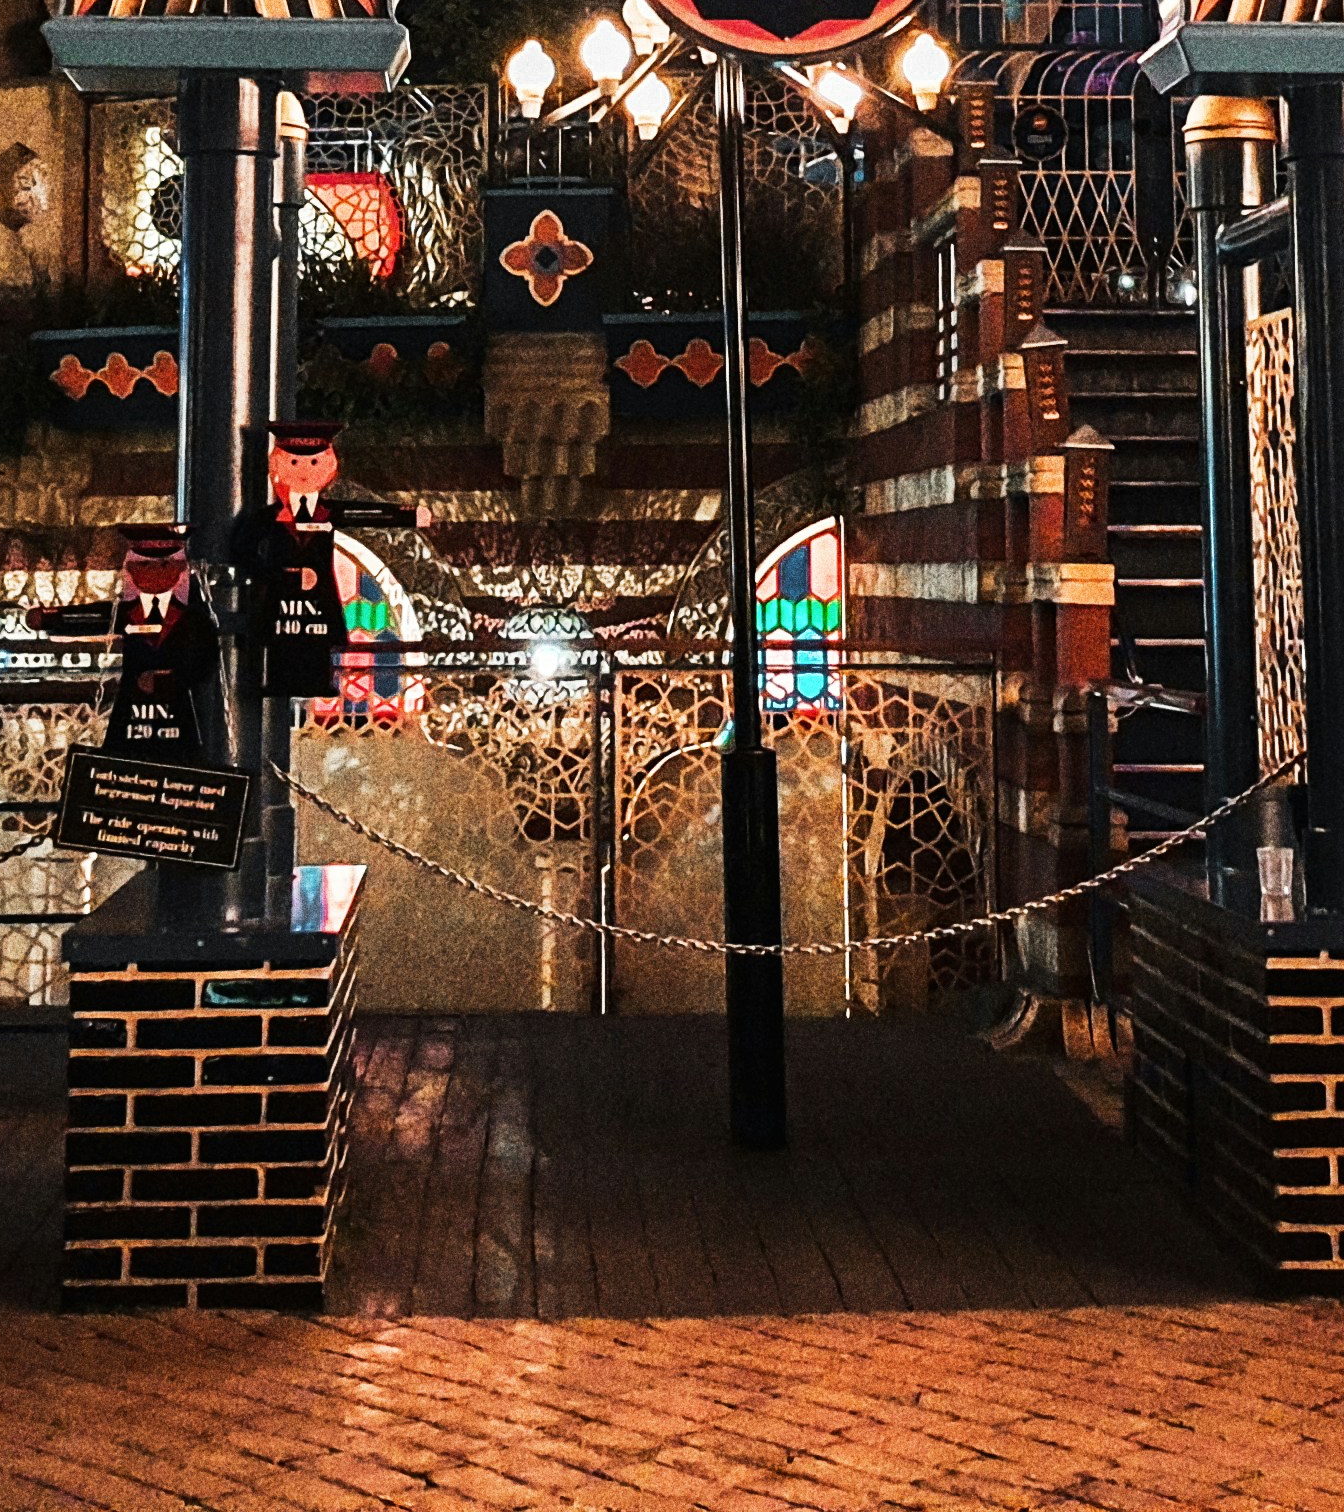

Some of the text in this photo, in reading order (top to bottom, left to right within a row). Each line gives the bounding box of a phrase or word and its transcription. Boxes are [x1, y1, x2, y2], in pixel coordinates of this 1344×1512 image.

[279, 599, 322, 616] MIN.
[275, 619, 328, 635] 140 cm
[131, 704, 174, 720] MIN.
[126, 724, 180, 739] 120 cm
[82, 811, 220, 841] The ride operates with
[97, 828, 142, 846] limited
